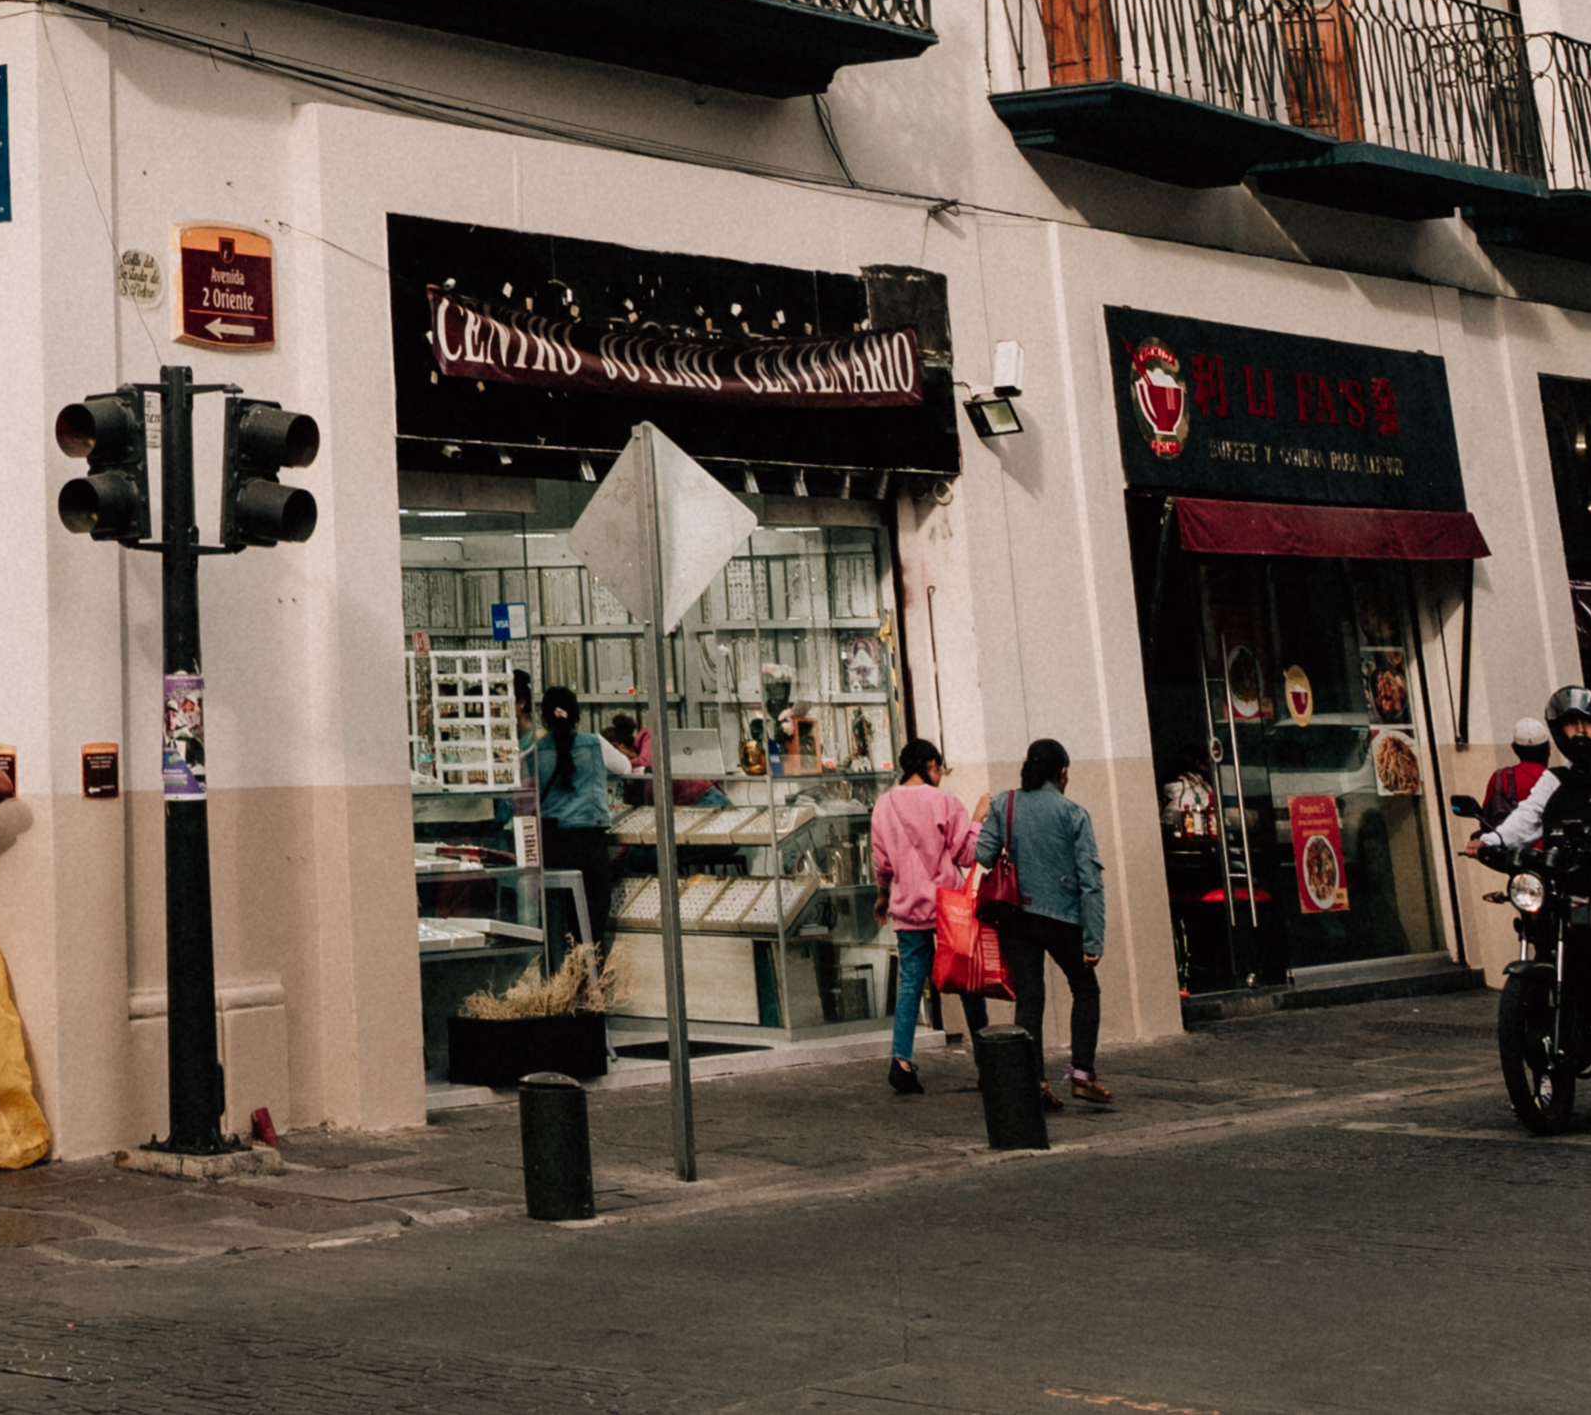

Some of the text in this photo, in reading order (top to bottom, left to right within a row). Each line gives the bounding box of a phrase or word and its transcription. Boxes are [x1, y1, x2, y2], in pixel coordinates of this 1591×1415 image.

[210, 267, 246, 285] Avenida
[202, 287, 255, 312] 2 Oriente
[436, 297, 582, 376] CENTRO
[734, 331, 916, 394] CENTENARIO
[1242, 365, 1366, 429] LI FA'S
[1208, 438, 1257, 464] BUFFET
[1264, 445, 1272, 464] Y
[1279, 445, 1325, 469] COMIDA
[1330, 450, 1361, 473] PARA
[495, 620, 509, 629] VISA
